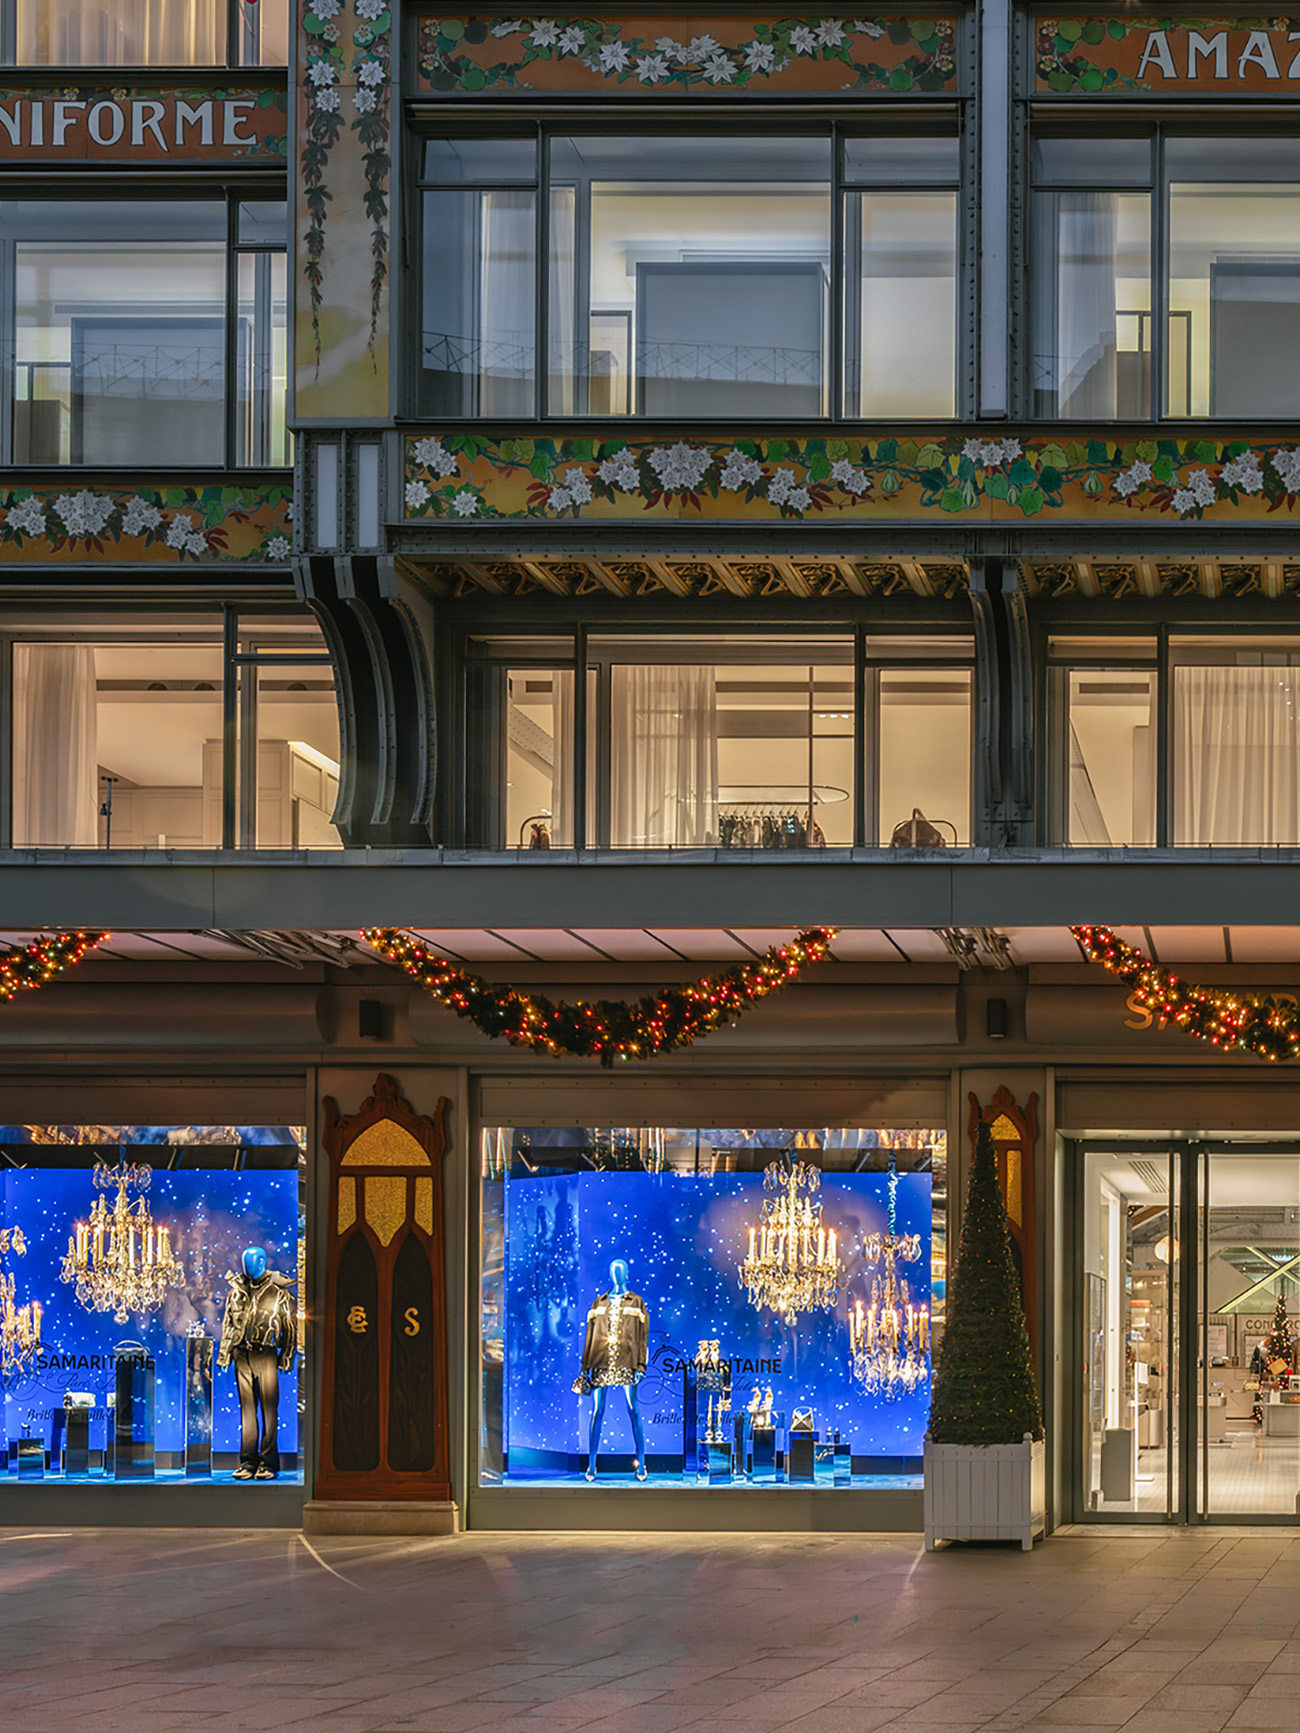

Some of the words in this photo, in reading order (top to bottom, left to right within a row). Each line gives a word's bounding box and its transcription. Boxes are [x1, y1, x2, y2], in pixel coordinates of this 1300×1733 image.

[404, 1307, 420, 1337] S
[36, 1354, 155, 1370] SAMARITAINE
[662, 1357, 782, 1374] SAMARITAINE
